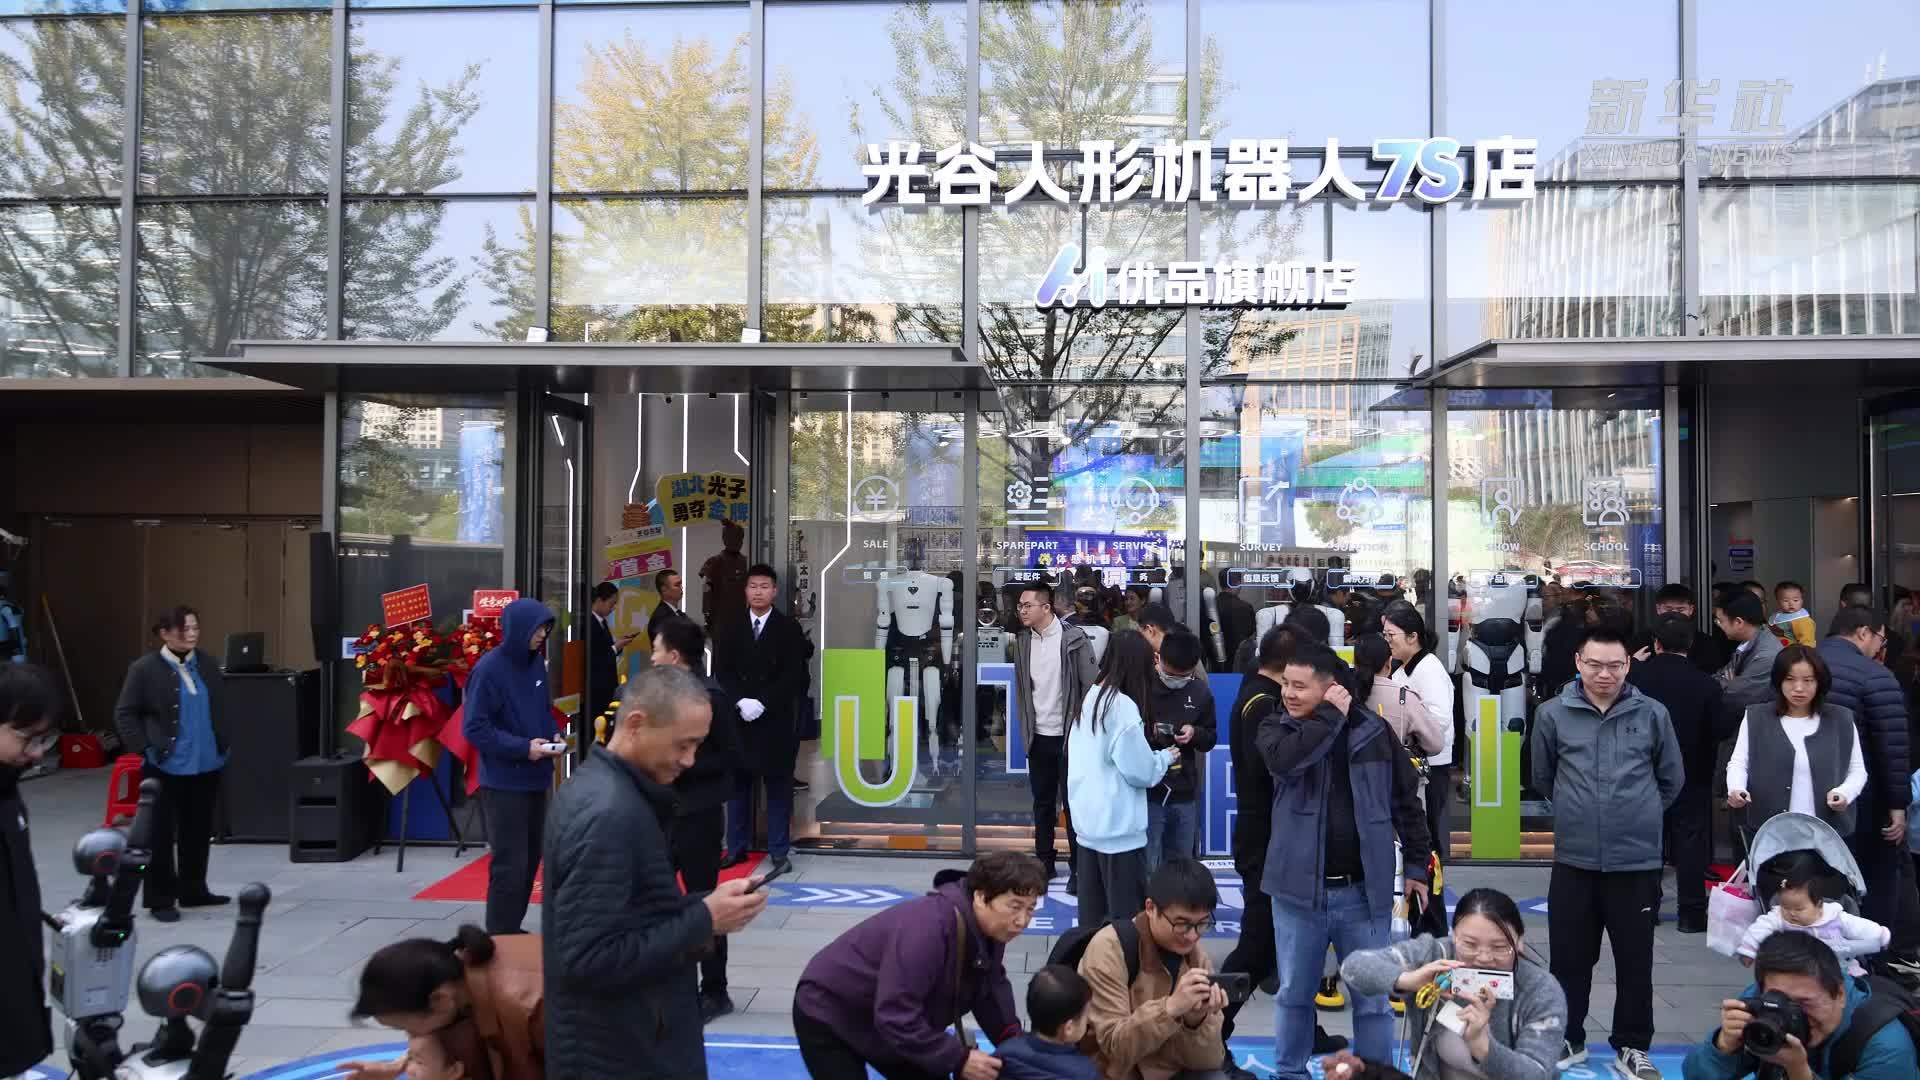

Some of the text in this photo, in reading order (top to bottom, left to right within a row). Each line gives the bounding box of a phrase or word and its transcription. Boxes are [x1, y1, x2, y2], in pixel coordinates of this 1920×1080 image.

[861, 136, 1537, 206] 光谷人形机器人7S店
[1115, 260, 1359, 306] 优品旗舰店
[671, 475, 747, 499] 湖北光子
[671, 499, 749, 522] 勇夺金牌
[863, 539, 889, 549] SALE
[996, 541, 1059, 550] SPAREPART
[1112, 541, 1158, 551] SERVICE
[1239, 543, 1282, 552] SURVEY
[1584, 543, 1629, 551] SCHOOL
[1014, 572, 1041, 582] 零配件
